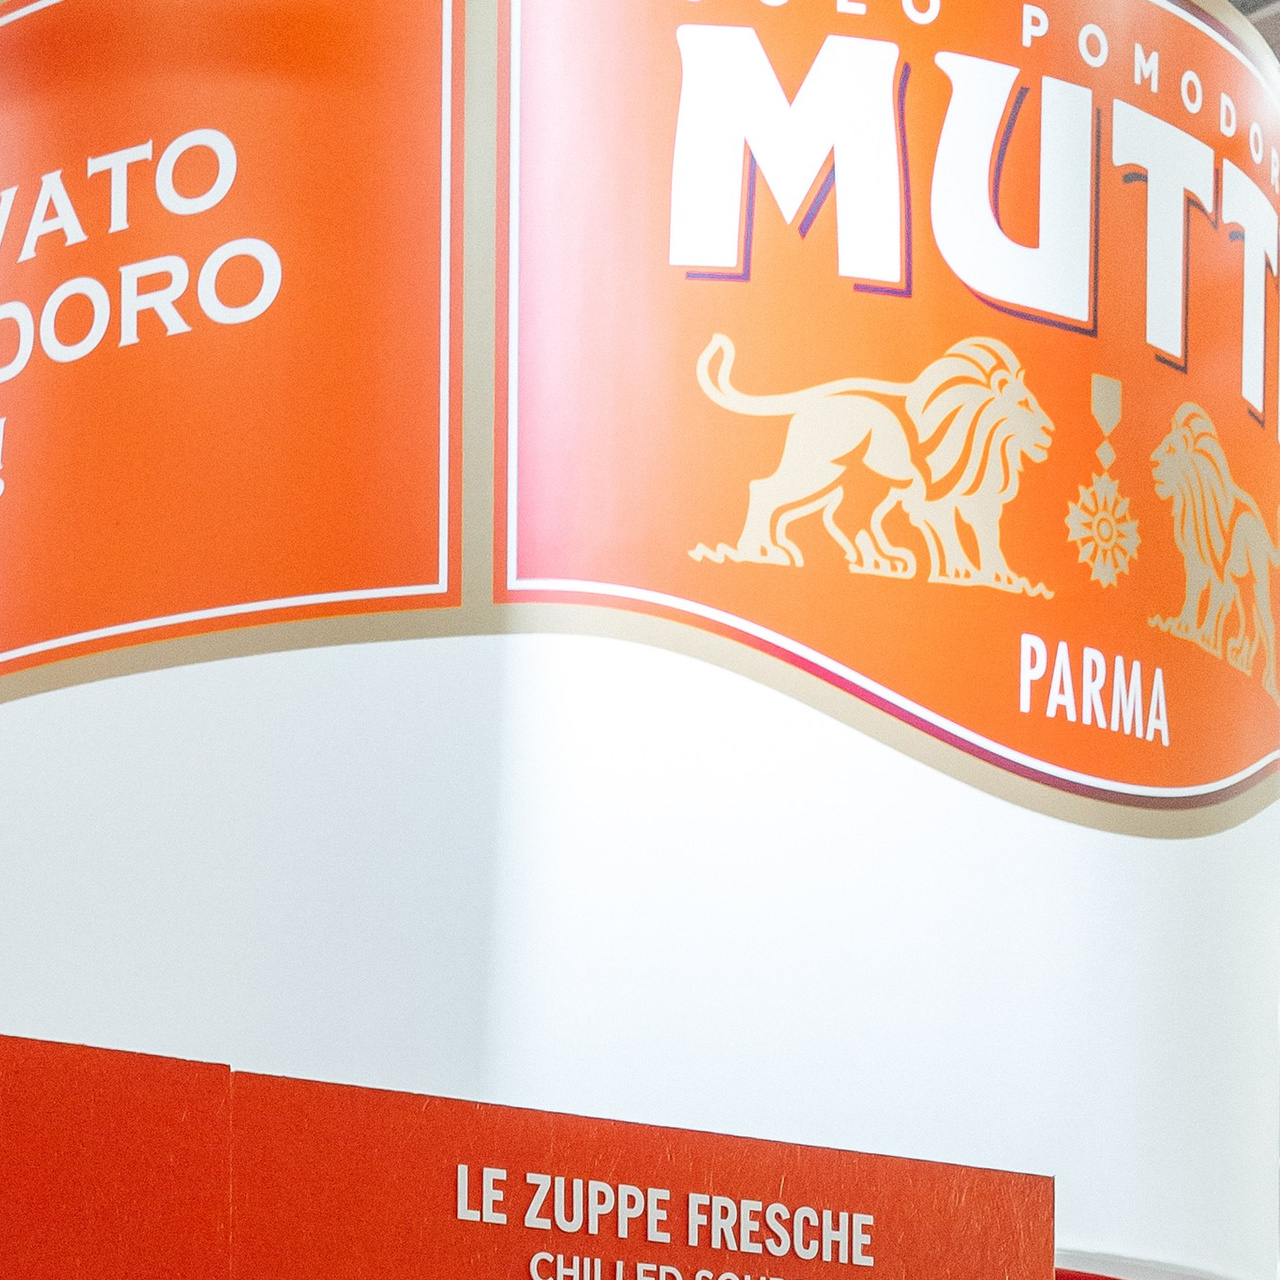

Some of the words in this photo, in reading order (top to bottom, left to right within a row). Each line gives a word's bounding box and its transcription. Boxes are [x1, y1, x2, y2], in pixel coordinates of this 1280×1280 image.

[1023, 3, 1280, 196] POMODOR
[668, 23, 1280, 416] MUTT
[1019, 633, 1171, 748] PARMA
[455, 1163, 508, 1225] LE
[524, 1172, 671, 1244] ZUPPE
[687, 1193, 875, 1267] FRESCHE
